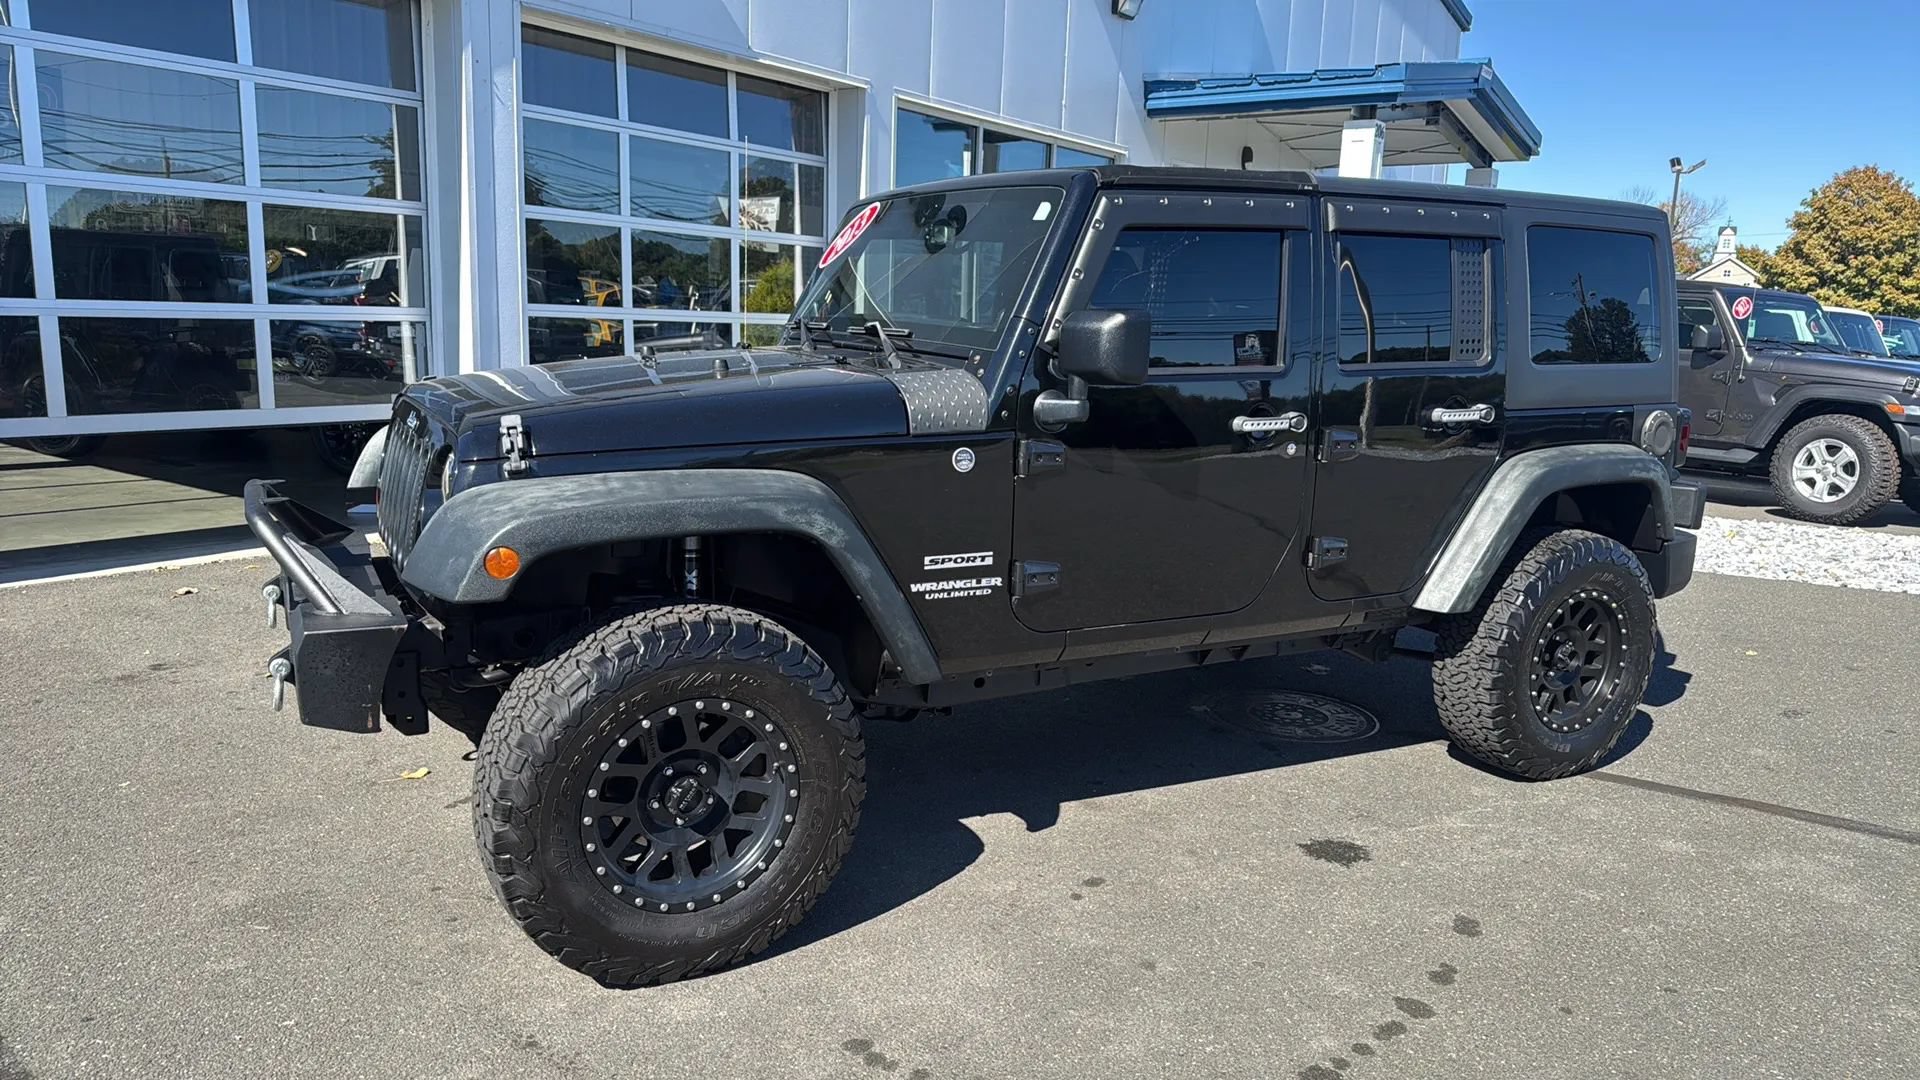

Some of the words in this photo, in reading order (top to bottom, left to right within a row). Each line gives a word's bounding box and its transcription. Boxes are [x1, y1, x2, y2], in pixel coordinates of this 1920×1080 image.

[927, 554, 992, 567] SPORT
[910, 577, 1003, 592] WRANGLER
[925, 588, 992, 600] UNLIMITED
